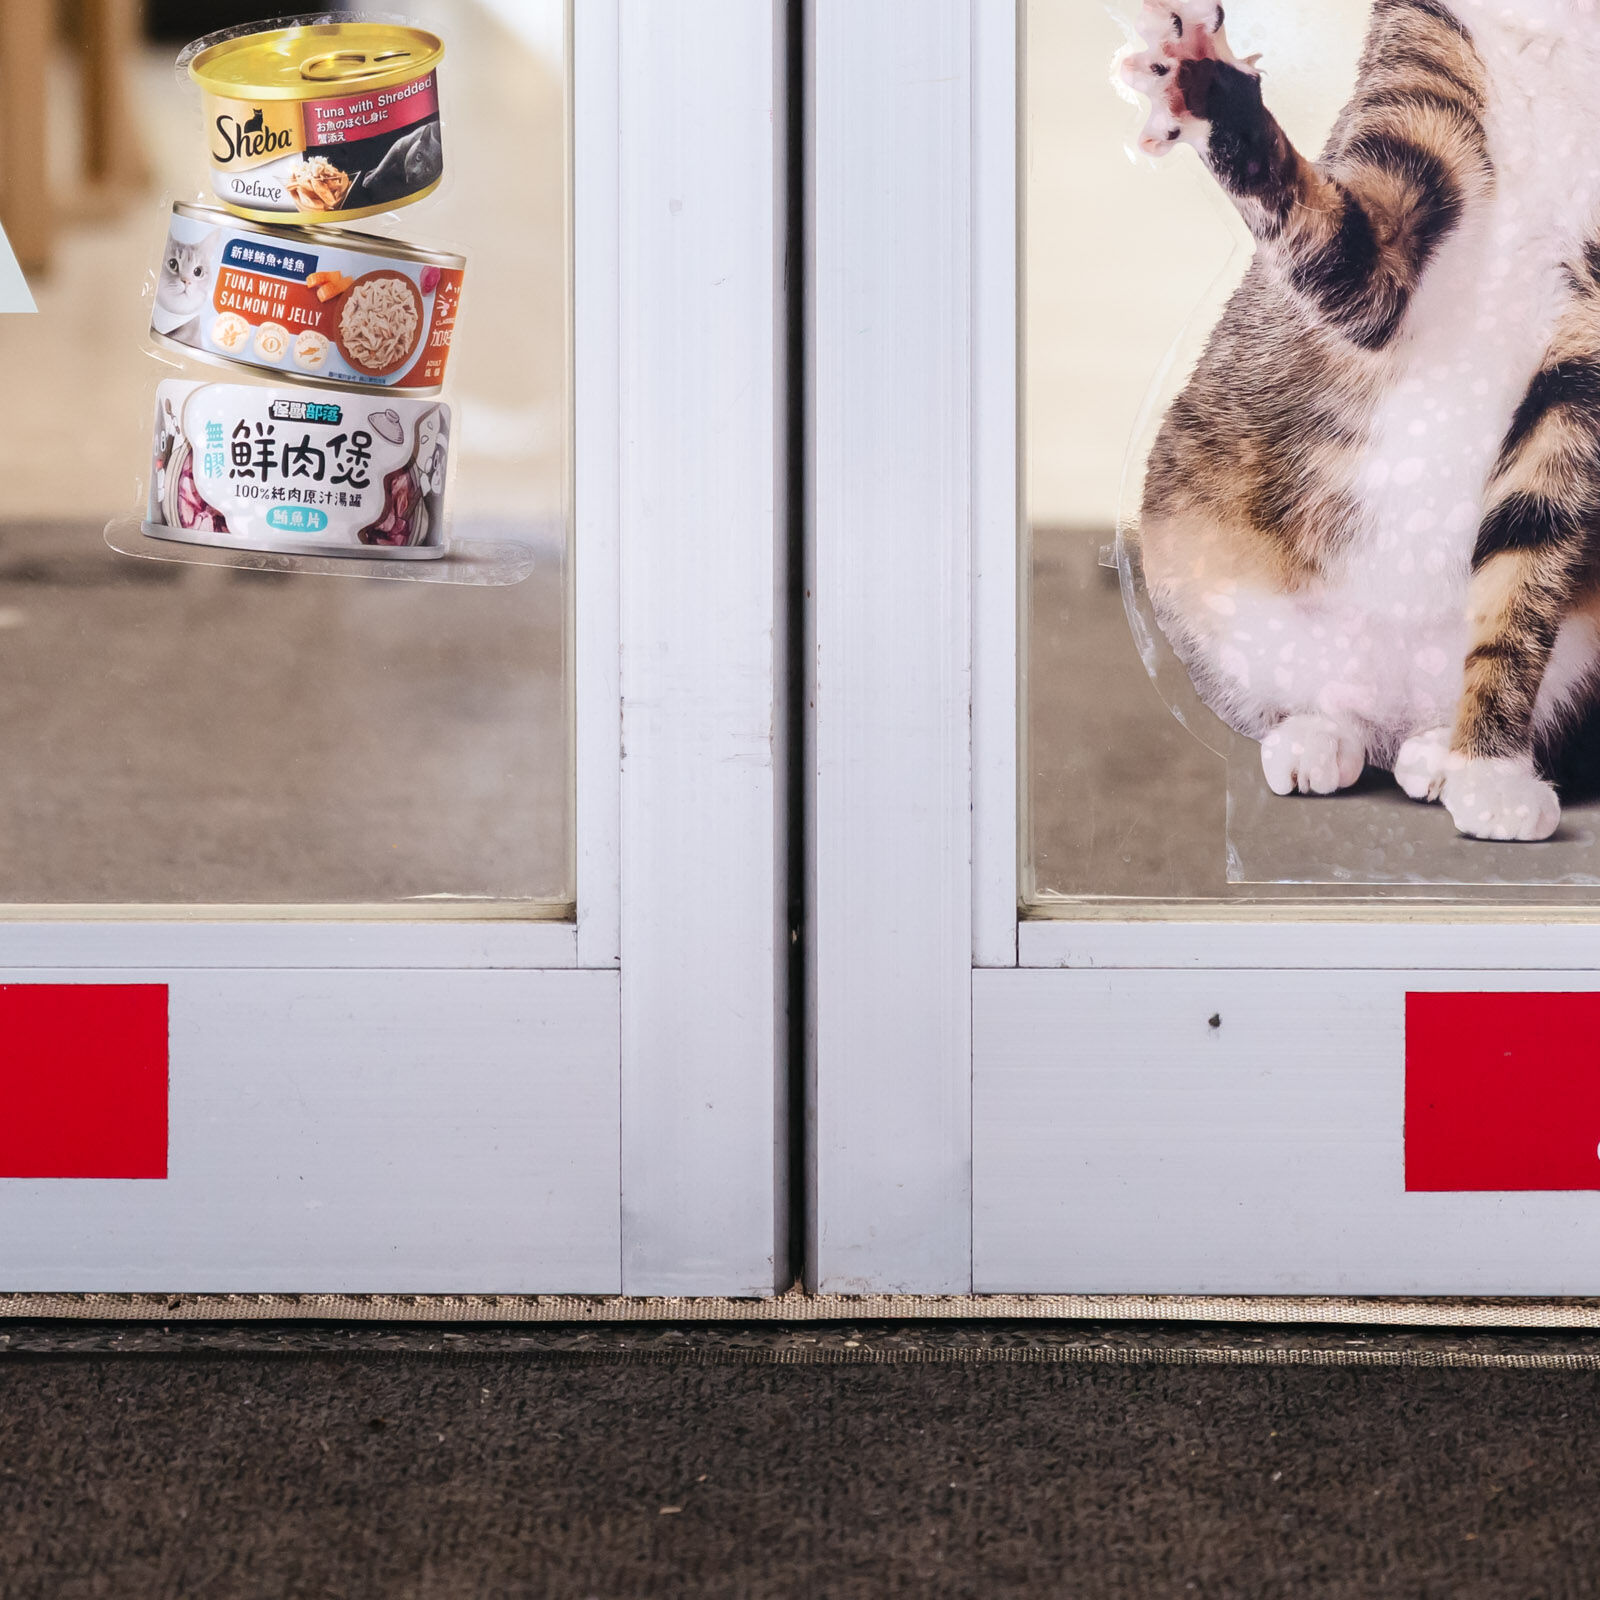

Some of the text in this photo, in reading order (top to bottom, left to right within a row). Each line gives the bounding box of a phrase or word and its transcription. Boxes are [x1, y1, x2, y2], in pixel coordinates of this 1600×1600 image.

[314, 75, 434, 121] Tuna with Shredded
[316, 109, 389, 133] お魚のほぐし身に
[212, 114, 293, 164] Sheba
[317, 131, 346, 145] 蟹添え
[230, 178, 282, 201] Deluxe
[229, 245, 307, 274] 新鮮鮪魚+鮭魚
[224, 273, 288, 299] TUNA WITH
[219, 294, 323, 328] SALMON IN JELLY
[272, 400, 342, 424] 怪獸部落
[204, 420, 225, 479] 無膠
[228, 418, 374, 490] 鮮肉煲
[234, 484, 363, 508] 100%純肉原汁湯罐
[272, 509, 321, 529] 鮪魚片
